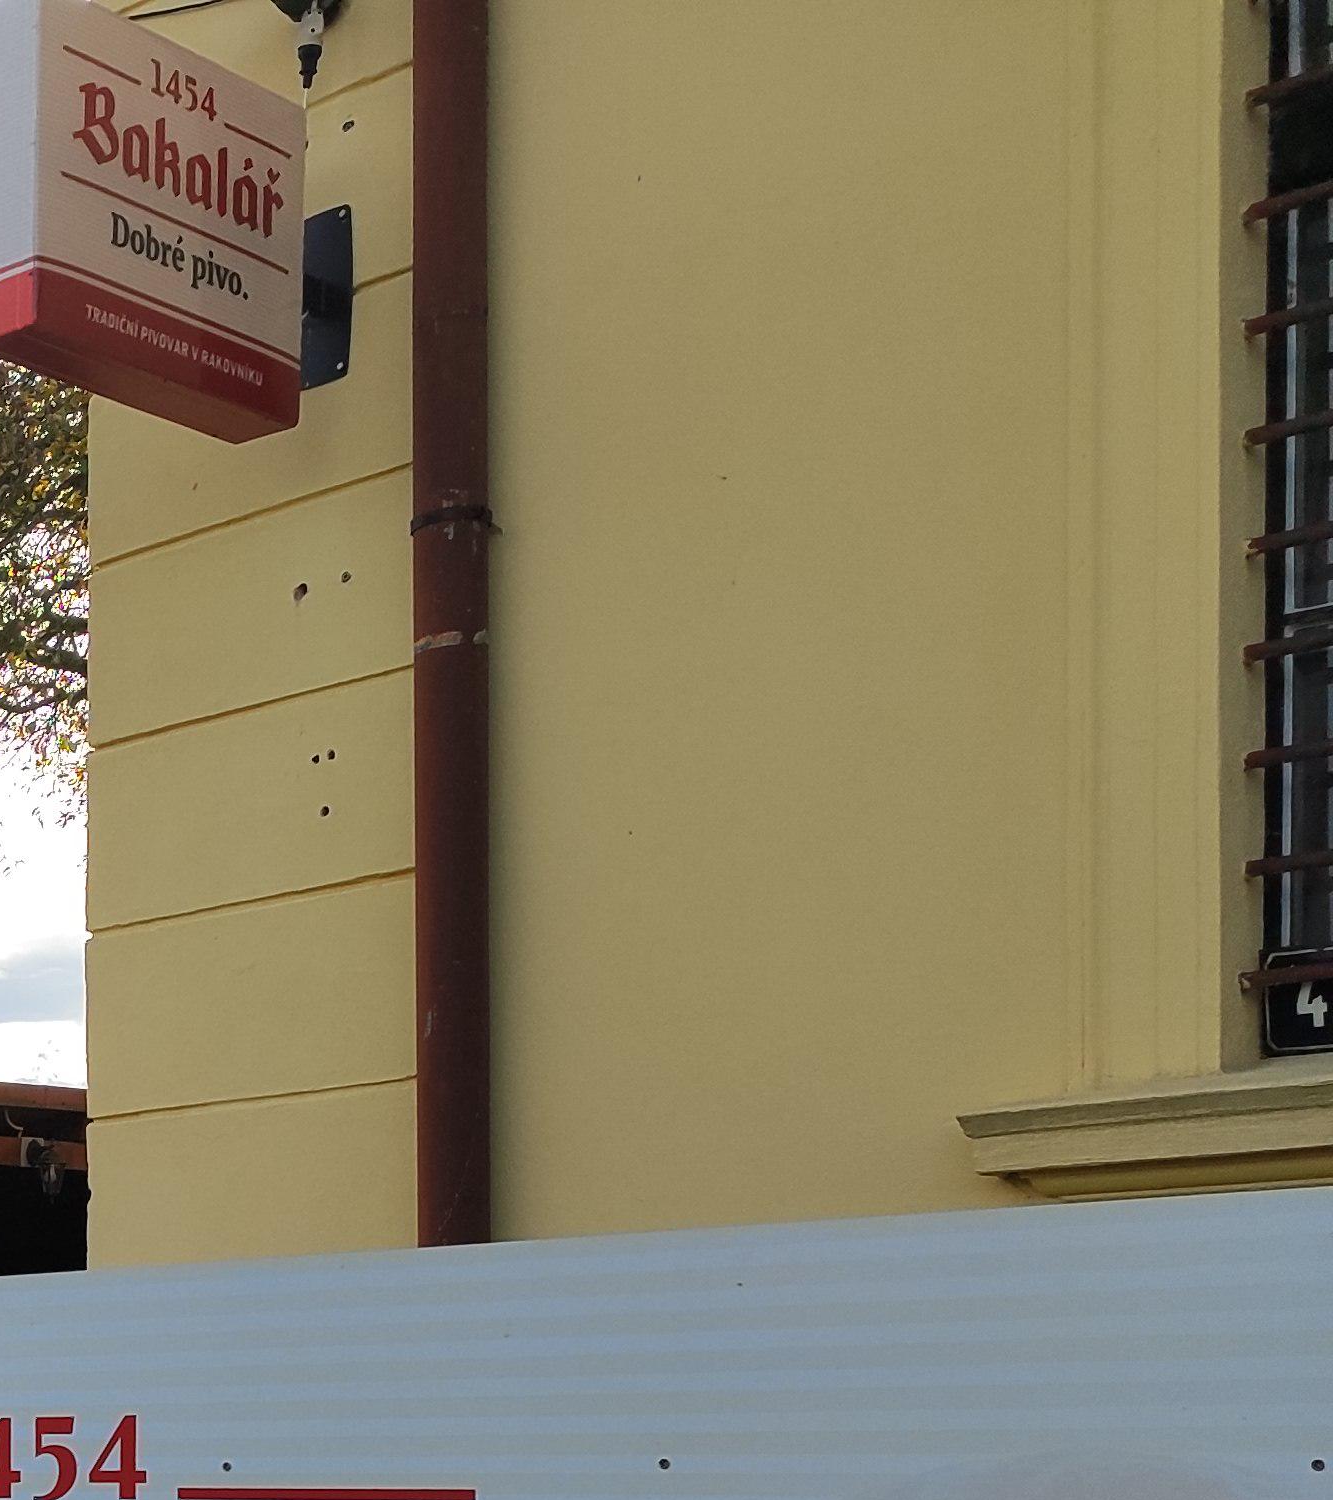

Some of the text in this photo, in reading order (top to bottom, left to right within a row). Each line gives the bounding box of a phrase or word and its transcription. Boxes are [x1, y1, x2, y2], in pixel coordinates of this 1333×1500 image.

[151, 58, 218, 122] 1454
[72, 82, 284, 238] Bakalář
[110, 212, 249, 301] Dobré pivo.
[85, 303, 264, 388] TRADIČNÍ PIVOVAR V RAKOVNÍKU
